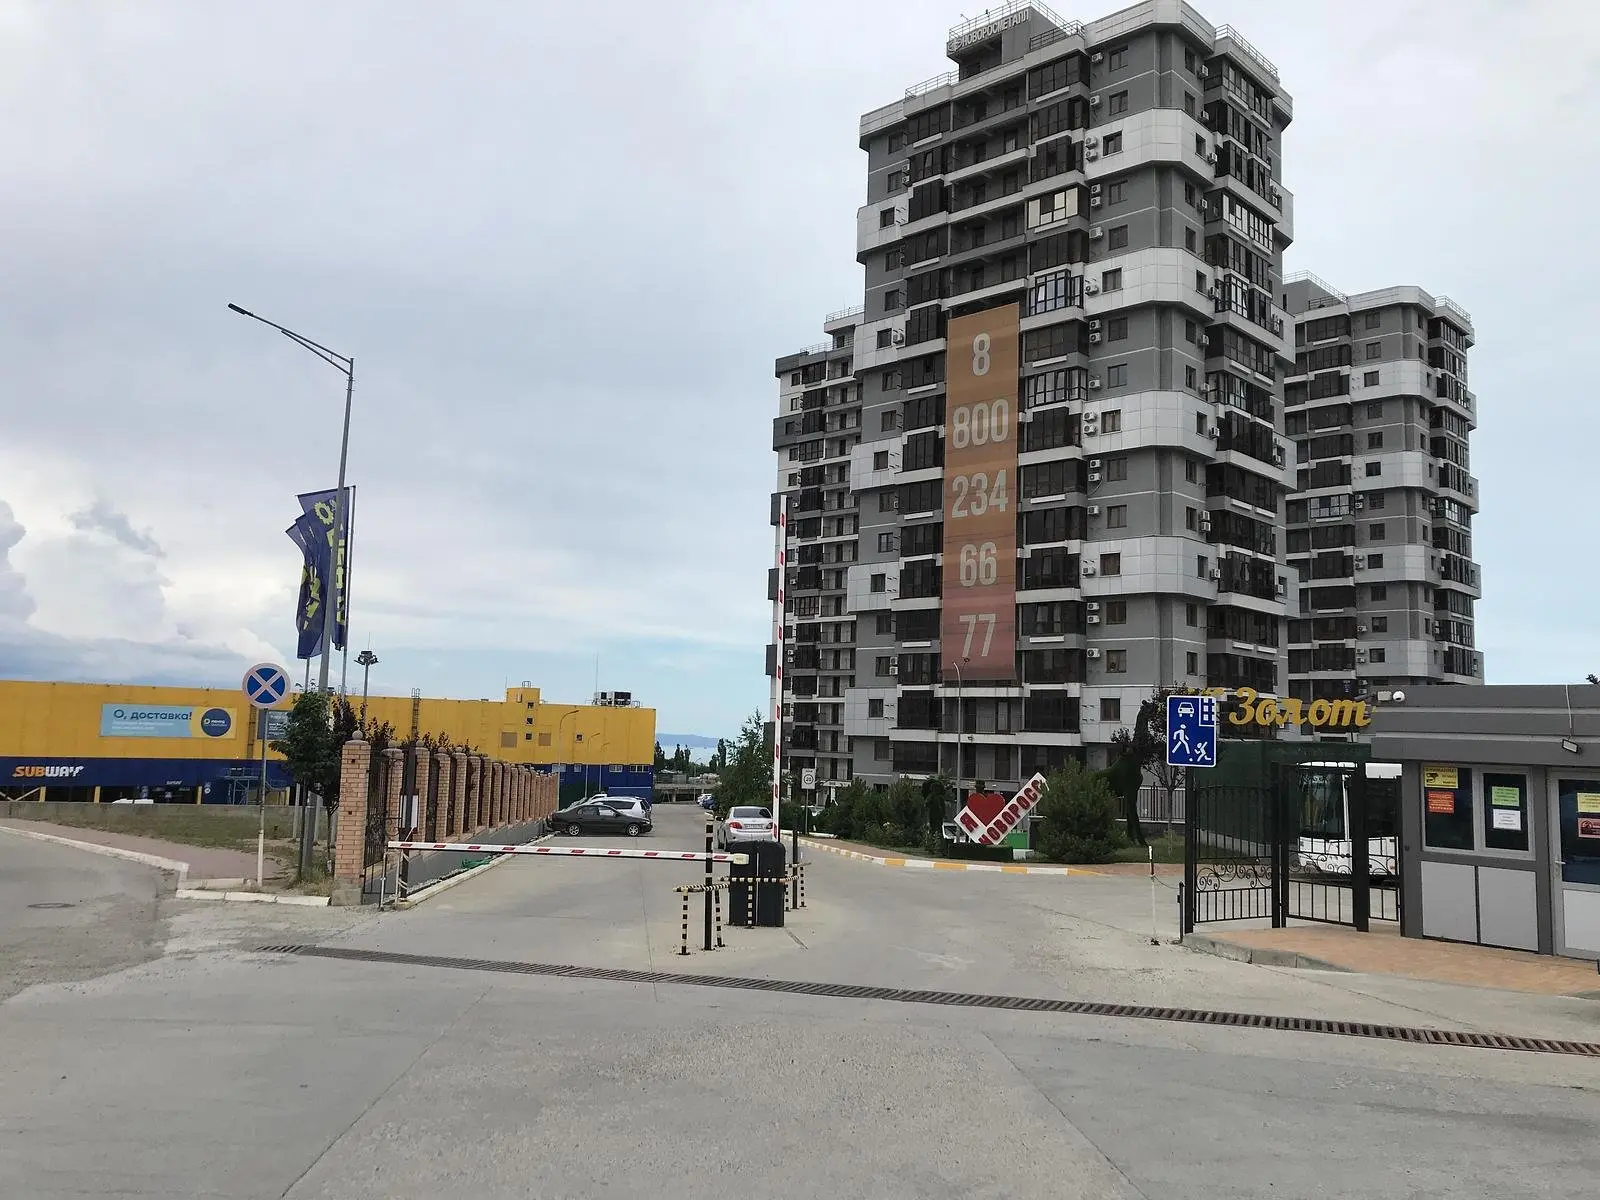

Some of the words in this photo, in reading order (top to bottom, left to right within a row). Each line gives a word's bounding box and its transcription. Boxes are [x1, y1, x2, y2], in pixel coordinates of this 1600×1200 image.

[971, 332, 991, 376] 8
[952, 398, 1009, 449] 800
[951, 469, 1009, 518] 234
[959, 541, 997, 587] 66
[959, 613, 996, 658] 77
[130, 711, 193, 720] доставка!
[1228, 686, 1376, 727] Золот
[12, 765, 85, 778] SUBWAY
[959, 811, 979, 833] Я
